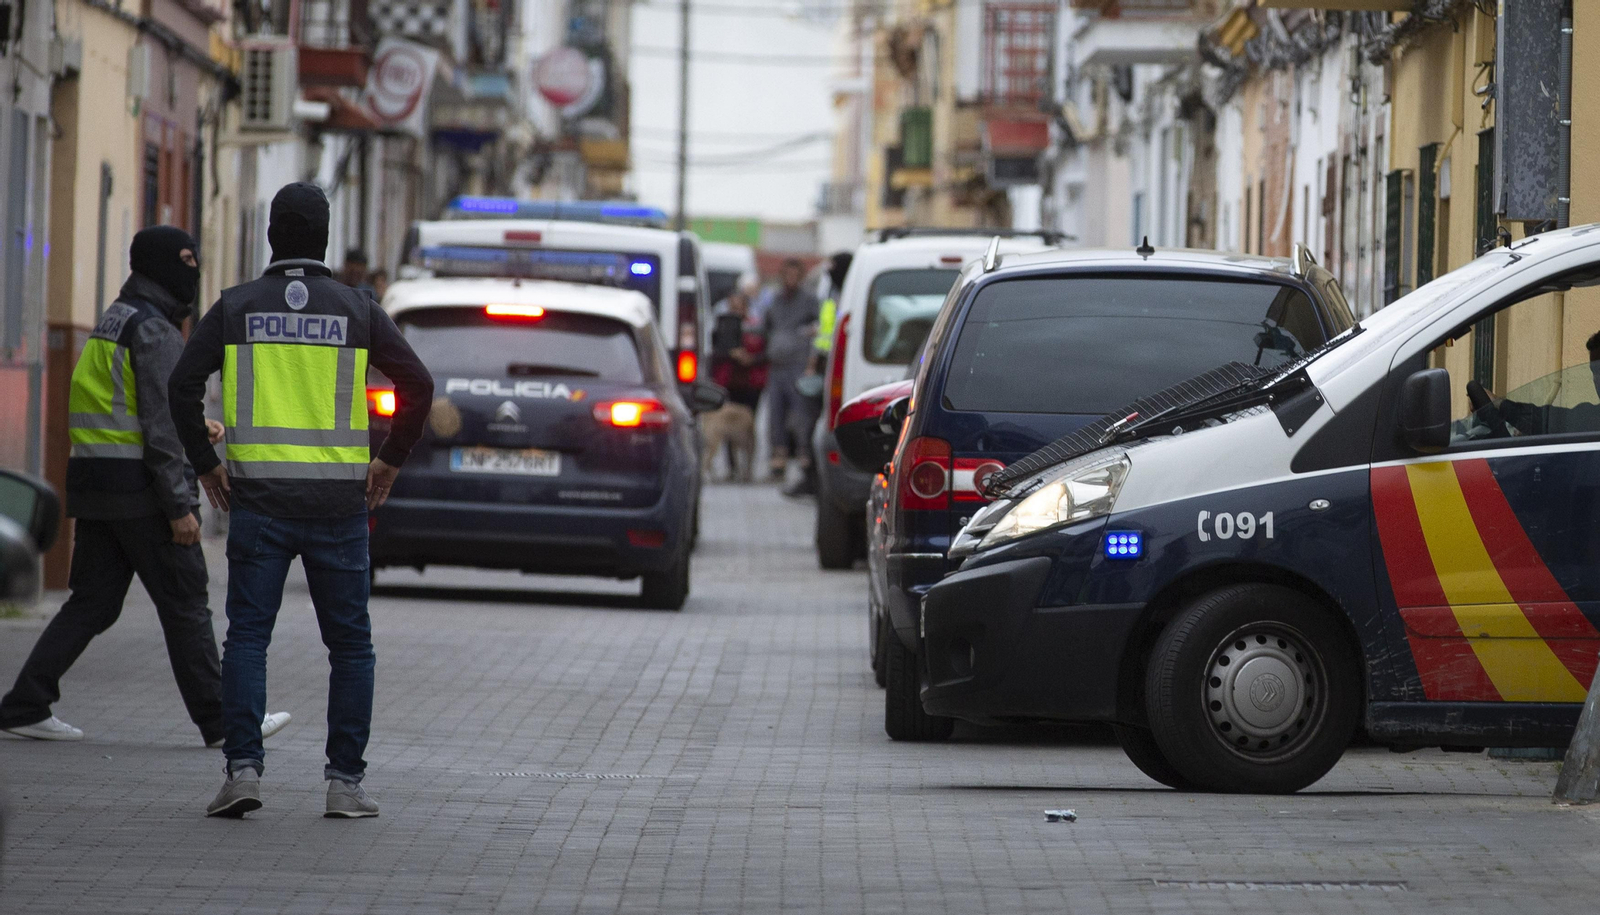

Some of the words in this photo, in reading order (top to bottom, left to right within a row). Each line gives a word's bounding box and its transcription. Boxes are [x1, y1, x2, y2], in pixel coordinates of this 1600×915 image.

[248, 316, 343, 340] POLICIA
[446, 378, 571, 399] POLICIA
[1214, 511, 1274, 539] 091
